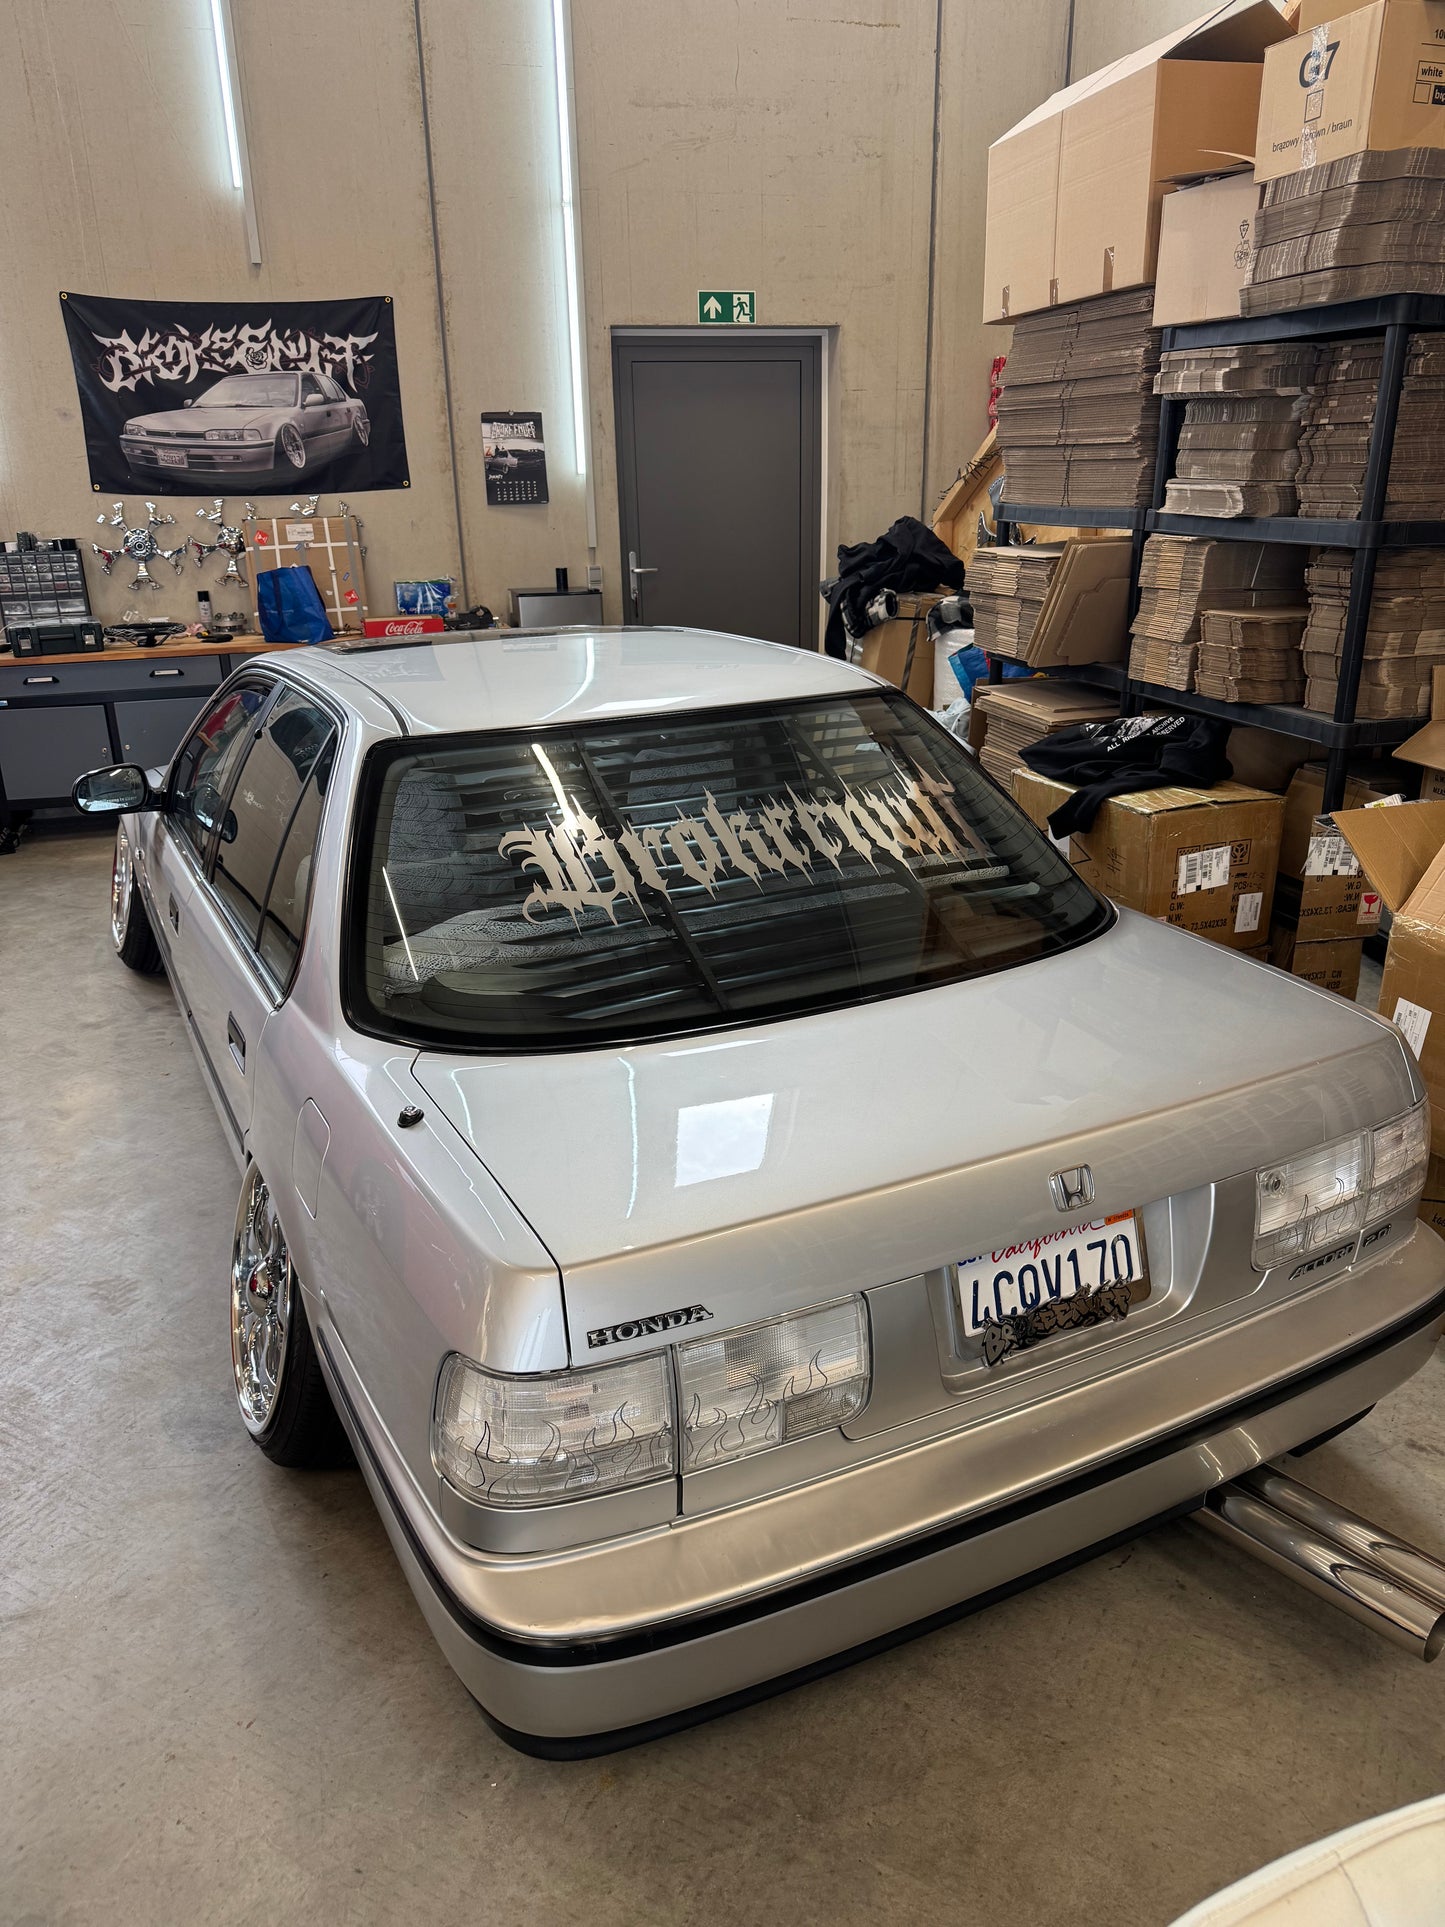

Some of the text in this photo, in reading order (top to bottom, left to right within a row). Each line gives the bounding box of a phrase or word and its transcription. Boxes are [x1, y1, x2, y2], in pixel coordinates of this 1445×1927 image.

[1421, 66, 1443, 77] white
[1272, 136, 1300, 152] brązowy
[1332, 118, 1352, 132] braun
[385, 621, 425, 636] Coca-Cola
[1152, 716, 1174, 734] ARCHIVE
[1106, 742, 1120, 752] ALL
[1288, 1242, 1356, 1280] ACCORD
[972, 1234, 1133, 1330] 4CQV170
[587, 1304, 714, 1348] HONDA
